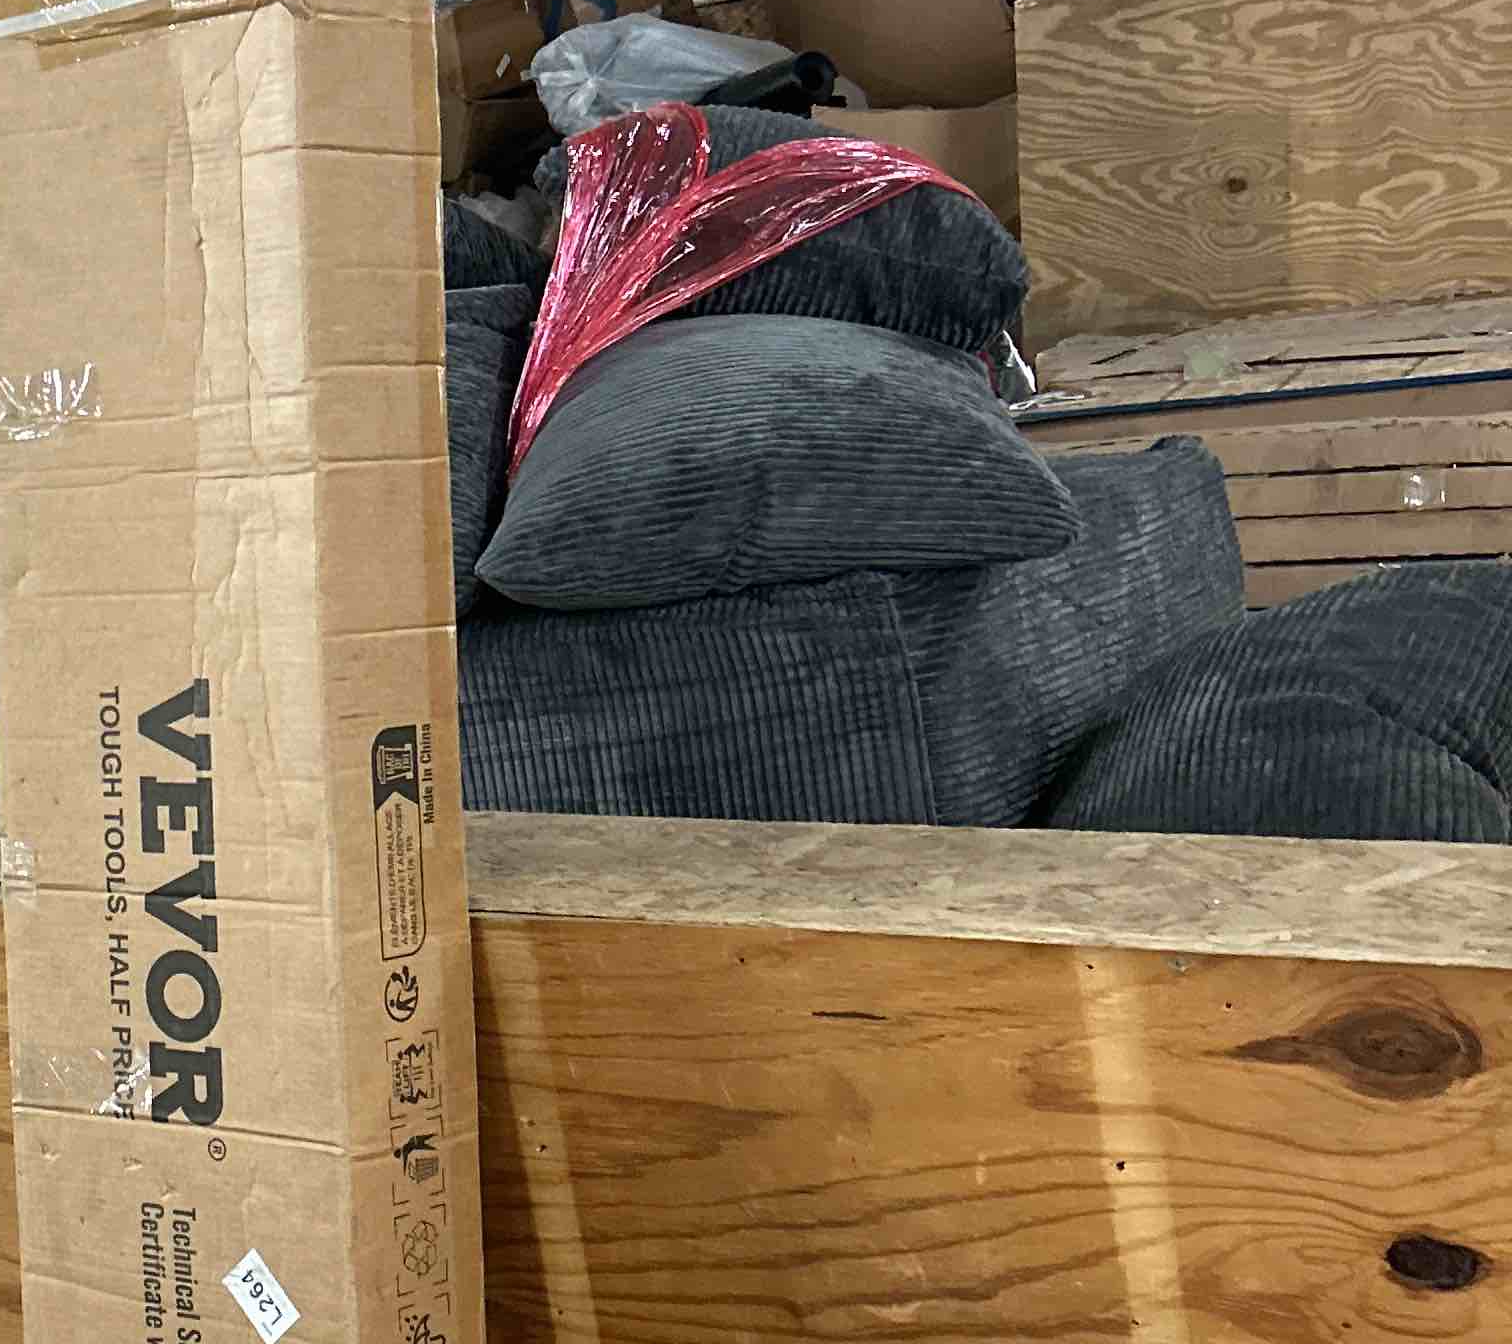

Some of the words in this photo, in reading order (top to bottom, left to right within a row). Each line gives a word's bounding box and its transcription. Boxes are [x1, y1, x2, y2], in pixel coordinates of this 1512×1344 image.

[98, 685, 123, 798] TOUGH
[420, 723, 432, 765] China
[422, 769, 433, 783] In
[423, 787, 435, 824] Made
[102, 807, 128, 921] TOOLS,
[137, 678, 224, 1127] VEVOR
[108, 932, 132, 1017] HALF
[141, 1202, 166, 1329] Certificate
[172, 1207, 200, 1320] Technical
